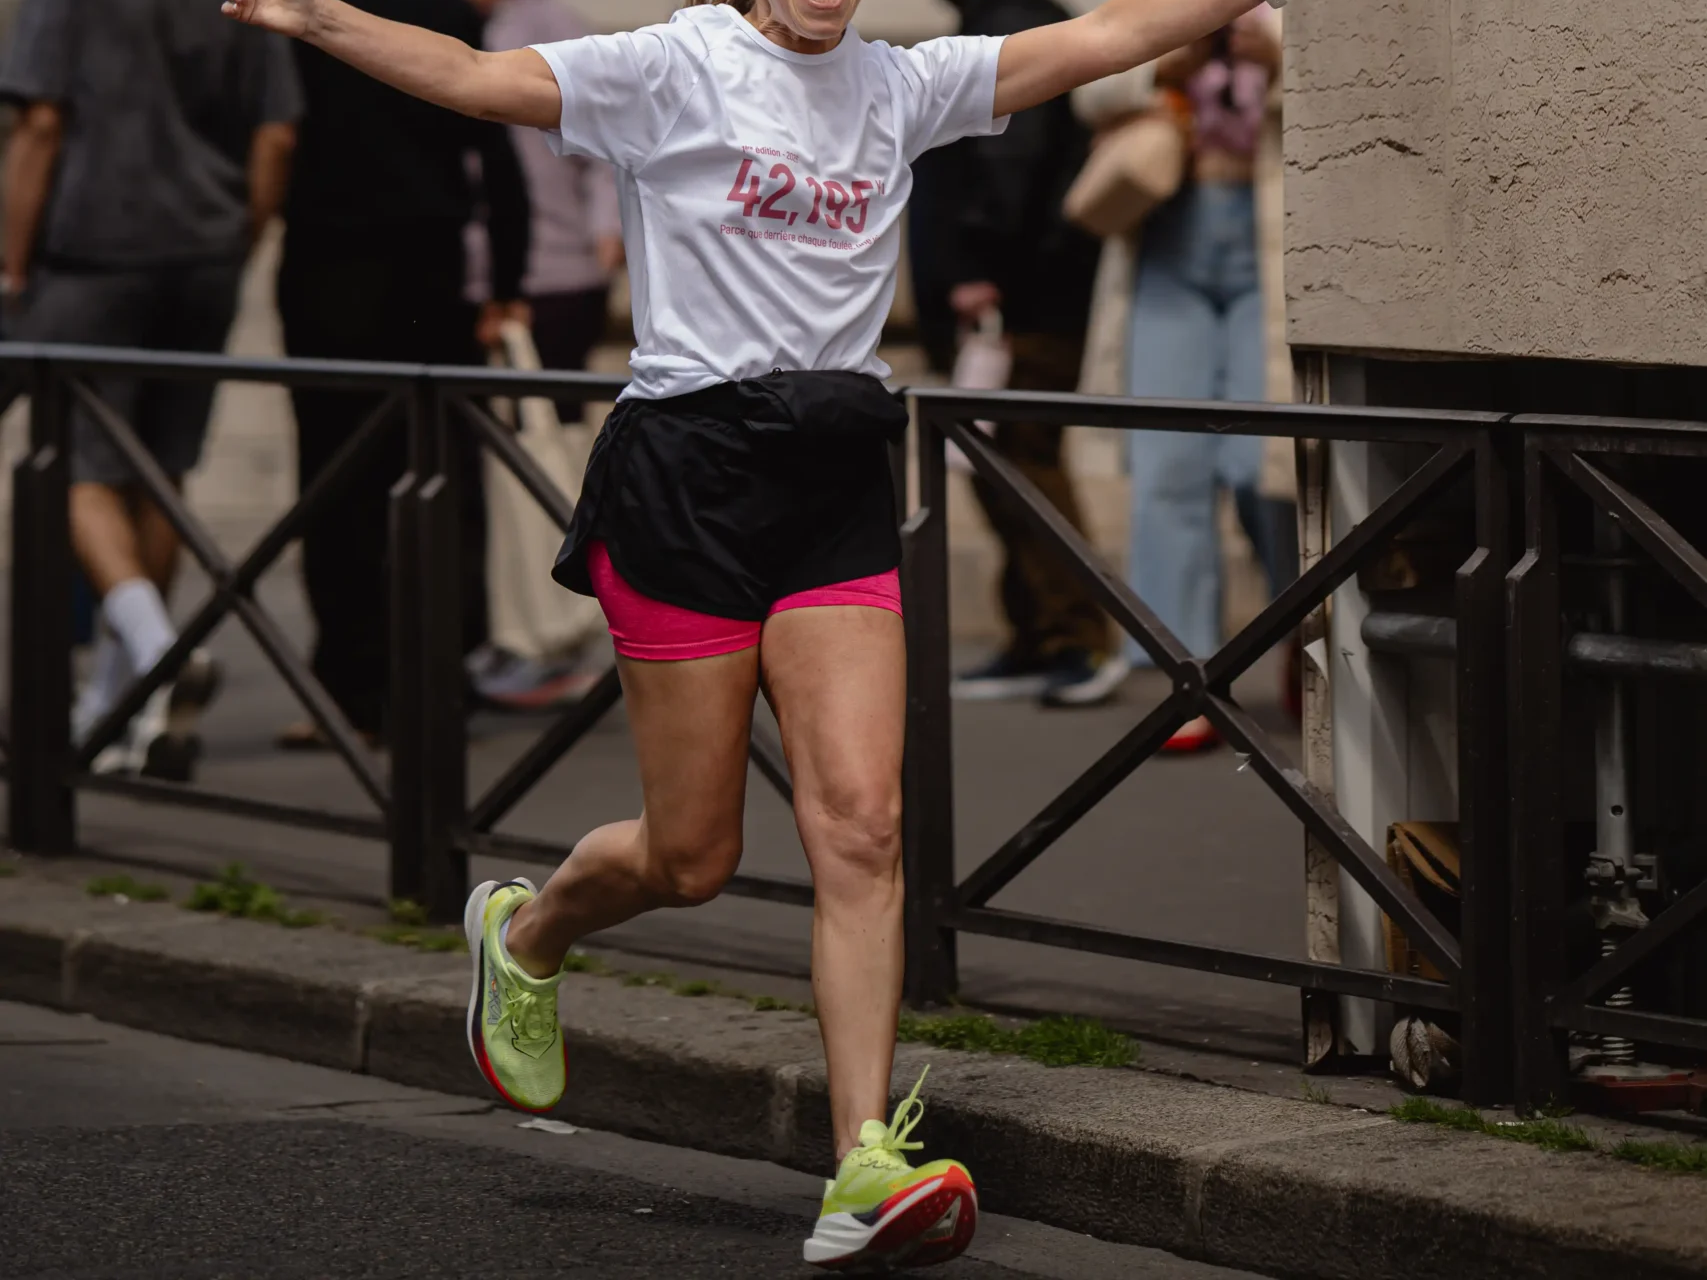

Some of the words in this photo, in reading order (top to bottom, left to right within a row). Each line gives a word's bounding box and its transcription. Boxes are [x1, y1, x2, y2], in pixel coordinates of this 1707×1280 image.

[727, 158, 873, 234] 42,195
[719, 224, 746, 236] Parce
[747, 229, 763, 240] que
[763, 228, 796, 242] derrière
[797, 233, 828, 248] chaque
